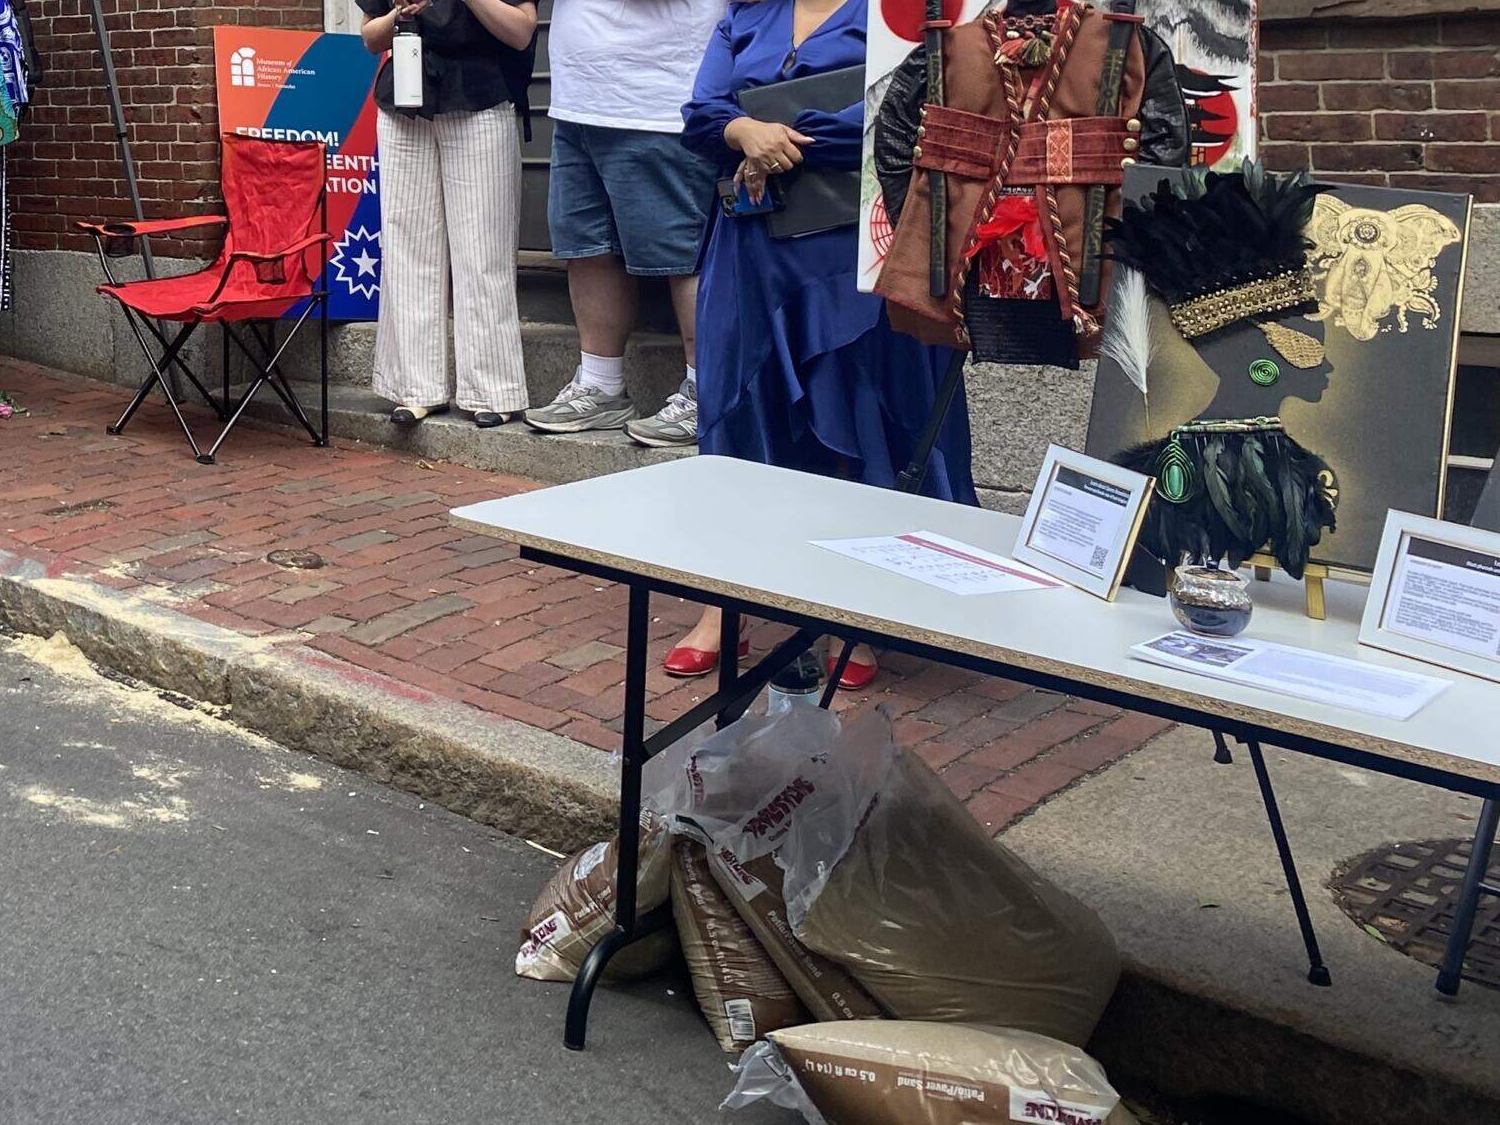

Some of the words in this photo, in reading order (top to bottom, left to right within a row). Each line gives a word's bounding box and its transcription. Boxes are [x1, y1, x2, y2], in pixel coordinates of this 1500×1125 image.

[257, 58, 286, 67] Museum
[257, 66, 282, 74] African
[283, 67, 316, 76] American
[257, 73, 283, 82] History
[832, 991, 846, 1007] 0.5
[843, 1006, 854, 1019] cu
[804, 1058, 814, 1072] L)
[817, 1061, 833, 1075] (14
[835, 1063, 843, 1076] ft
[845, 1066, 857, 1076] cu
[860, 1069, 876, 1083] 0.5
[897, 1076, 923, 1091] Sand
[926, 1080, 985, 1102] Patio/Paver
